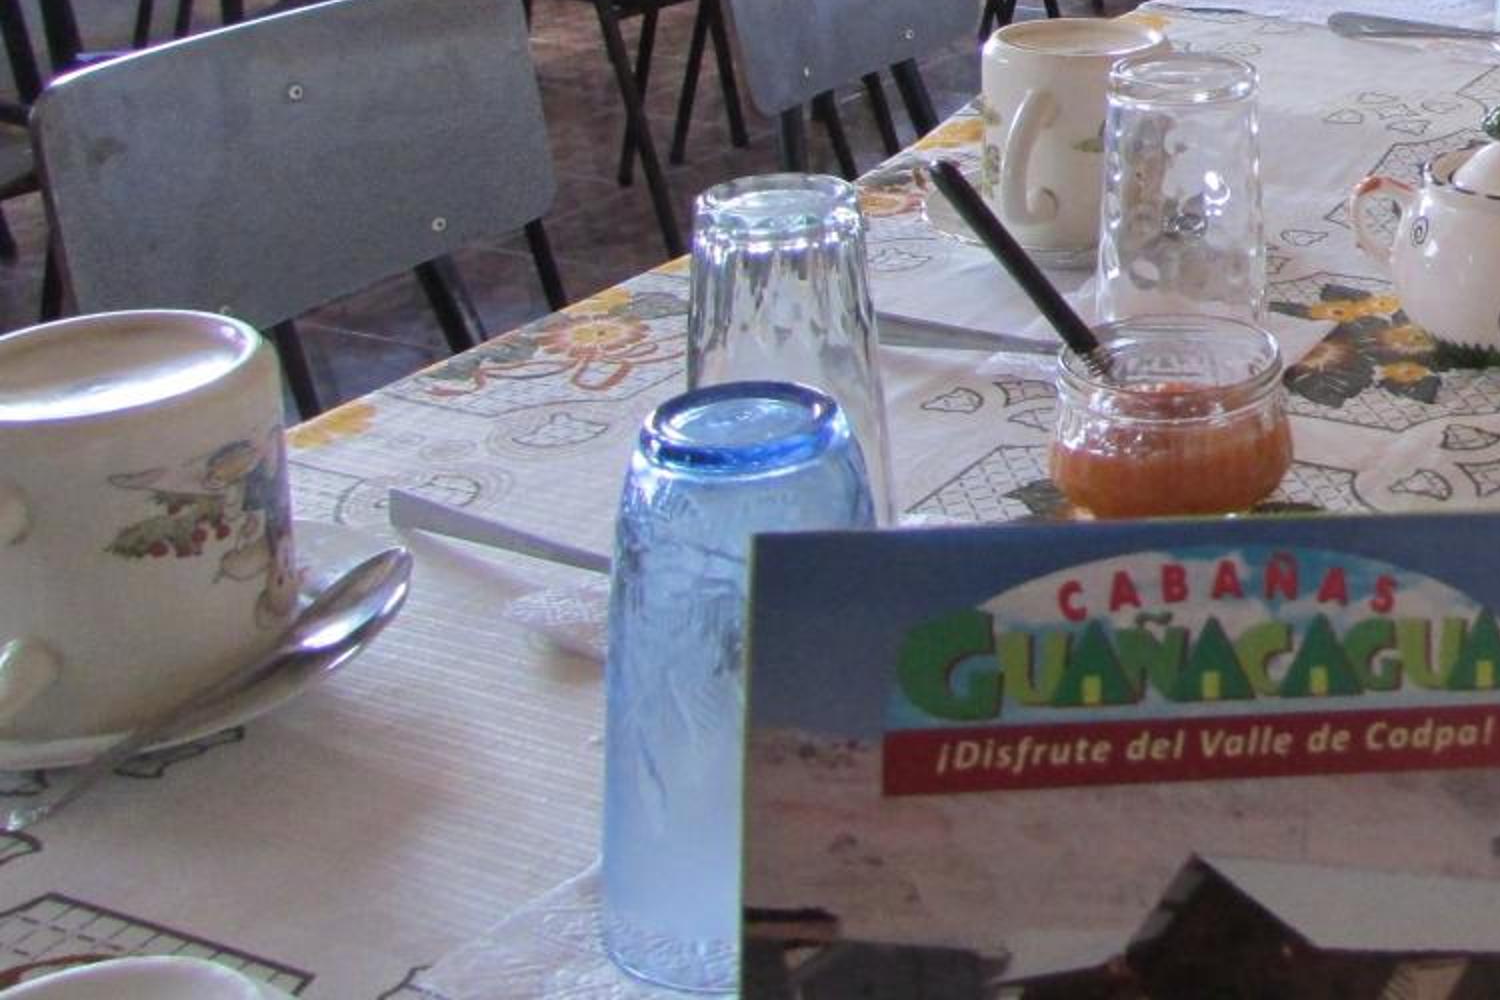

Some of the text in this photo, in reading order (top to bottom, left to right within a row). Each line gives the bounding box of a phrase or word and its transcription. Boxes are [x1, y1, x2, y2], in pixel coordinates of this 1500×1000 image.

[1058, 551, 1397, 622] CABAÑAS
[936, 715, 1496, 774] ¡Disfrute del Valle de Codpa!
